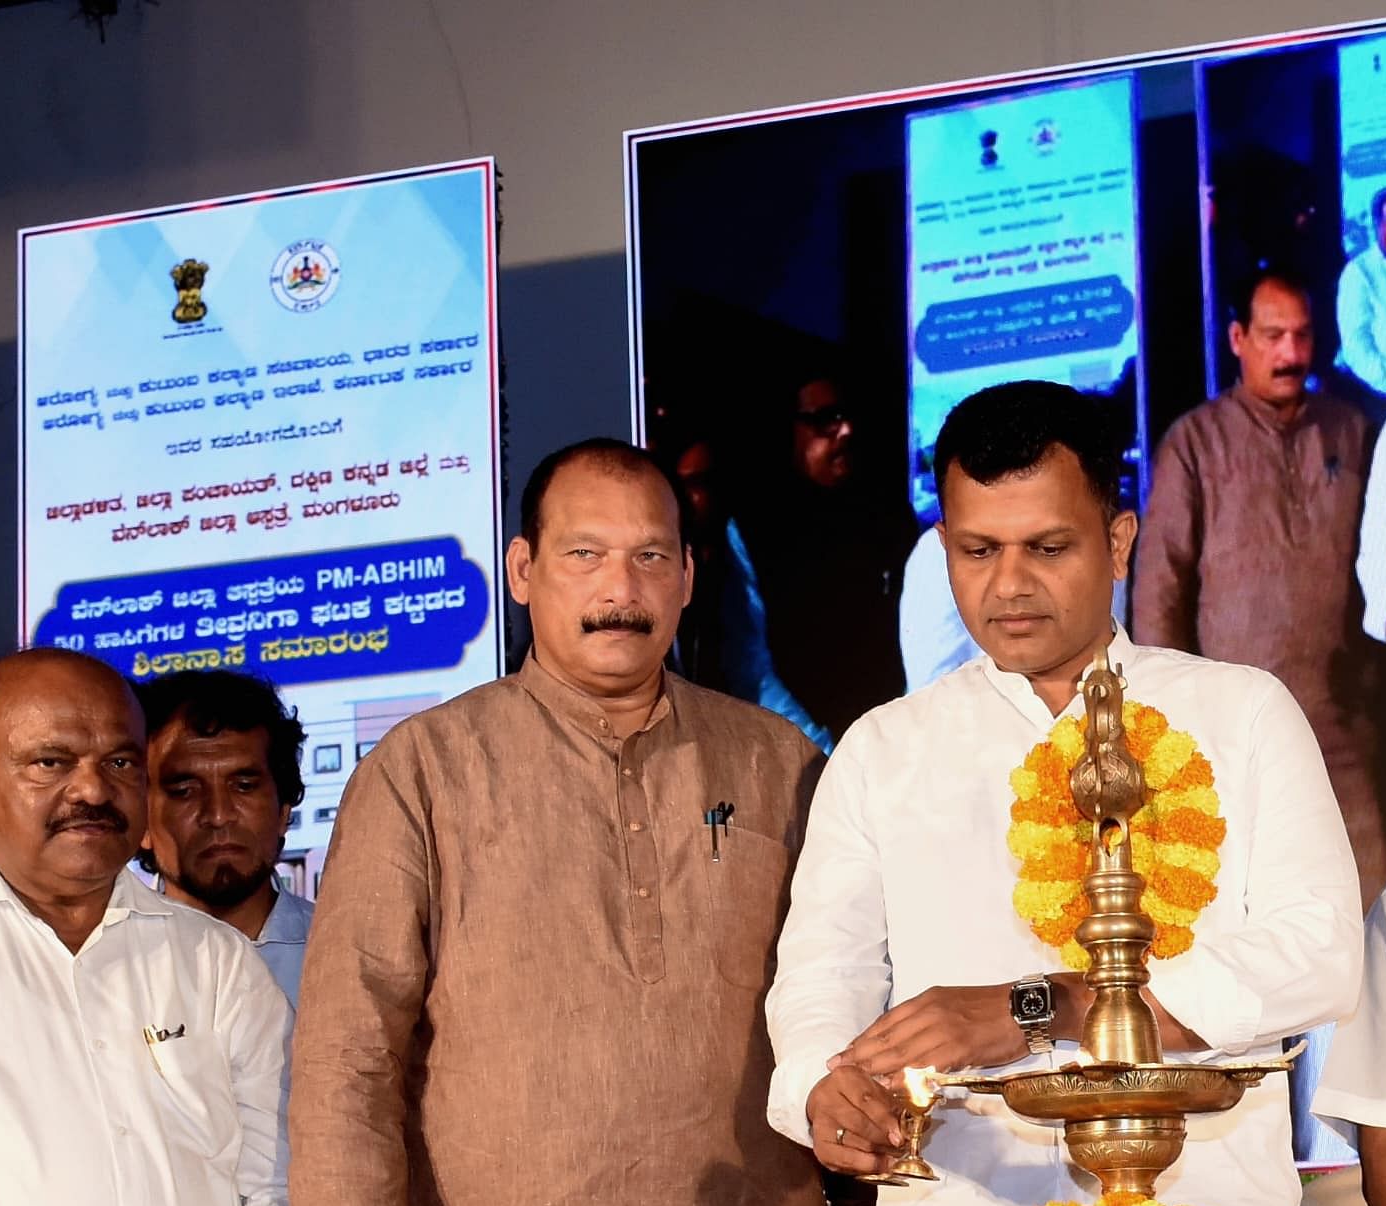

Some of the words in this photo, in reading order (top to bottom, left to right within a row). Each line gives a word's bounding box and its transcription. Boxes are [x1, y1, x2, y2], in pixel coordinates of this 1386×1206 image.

[138, 374, 200, 393] ಕುಟುಂಬ
[207, 366, 258, 388] ಕಲ್ಯಾಣ
[363, 343, 411, 364] ಭಾರತ
[420, 333, 479, 355] ಸರ್ಕಾರ
[145, 398, 206, 416] ಕುಟುಂಬ
[214, 389, 264, 410] ಕಲ್ಯಾಣ
[333, 367, 405, 391] ಕರ್ನಾಟಕ
[414, 358, 473, 380] ಸರ್ಕಾರ
[165, 437, 202, 455] ಇವರ
[136, 491, 173, 511] ಜಿಲ್ಲಾ
[290, 471, 333, 494] ದಕ್ಷಿಣ
[342, 459, 390, 486] ಕನ್ನಡ
[199, 513, 237, 534] ಜಿಲ್ಲಾ
[301, 489, 402, 519] ಮಂಗಳೂರು
[172, 587, 217, 610] ಜಿಲ್ಲಾ
[316, 555, 446, 592] PM-ABHIM
[311, 595, 372, 627] ಘಟಕ
[383, 585, 466, 625] ಕಟ್ಟಡದ
[259, 624, 390, 663] ಸಮಾರಂಭ
